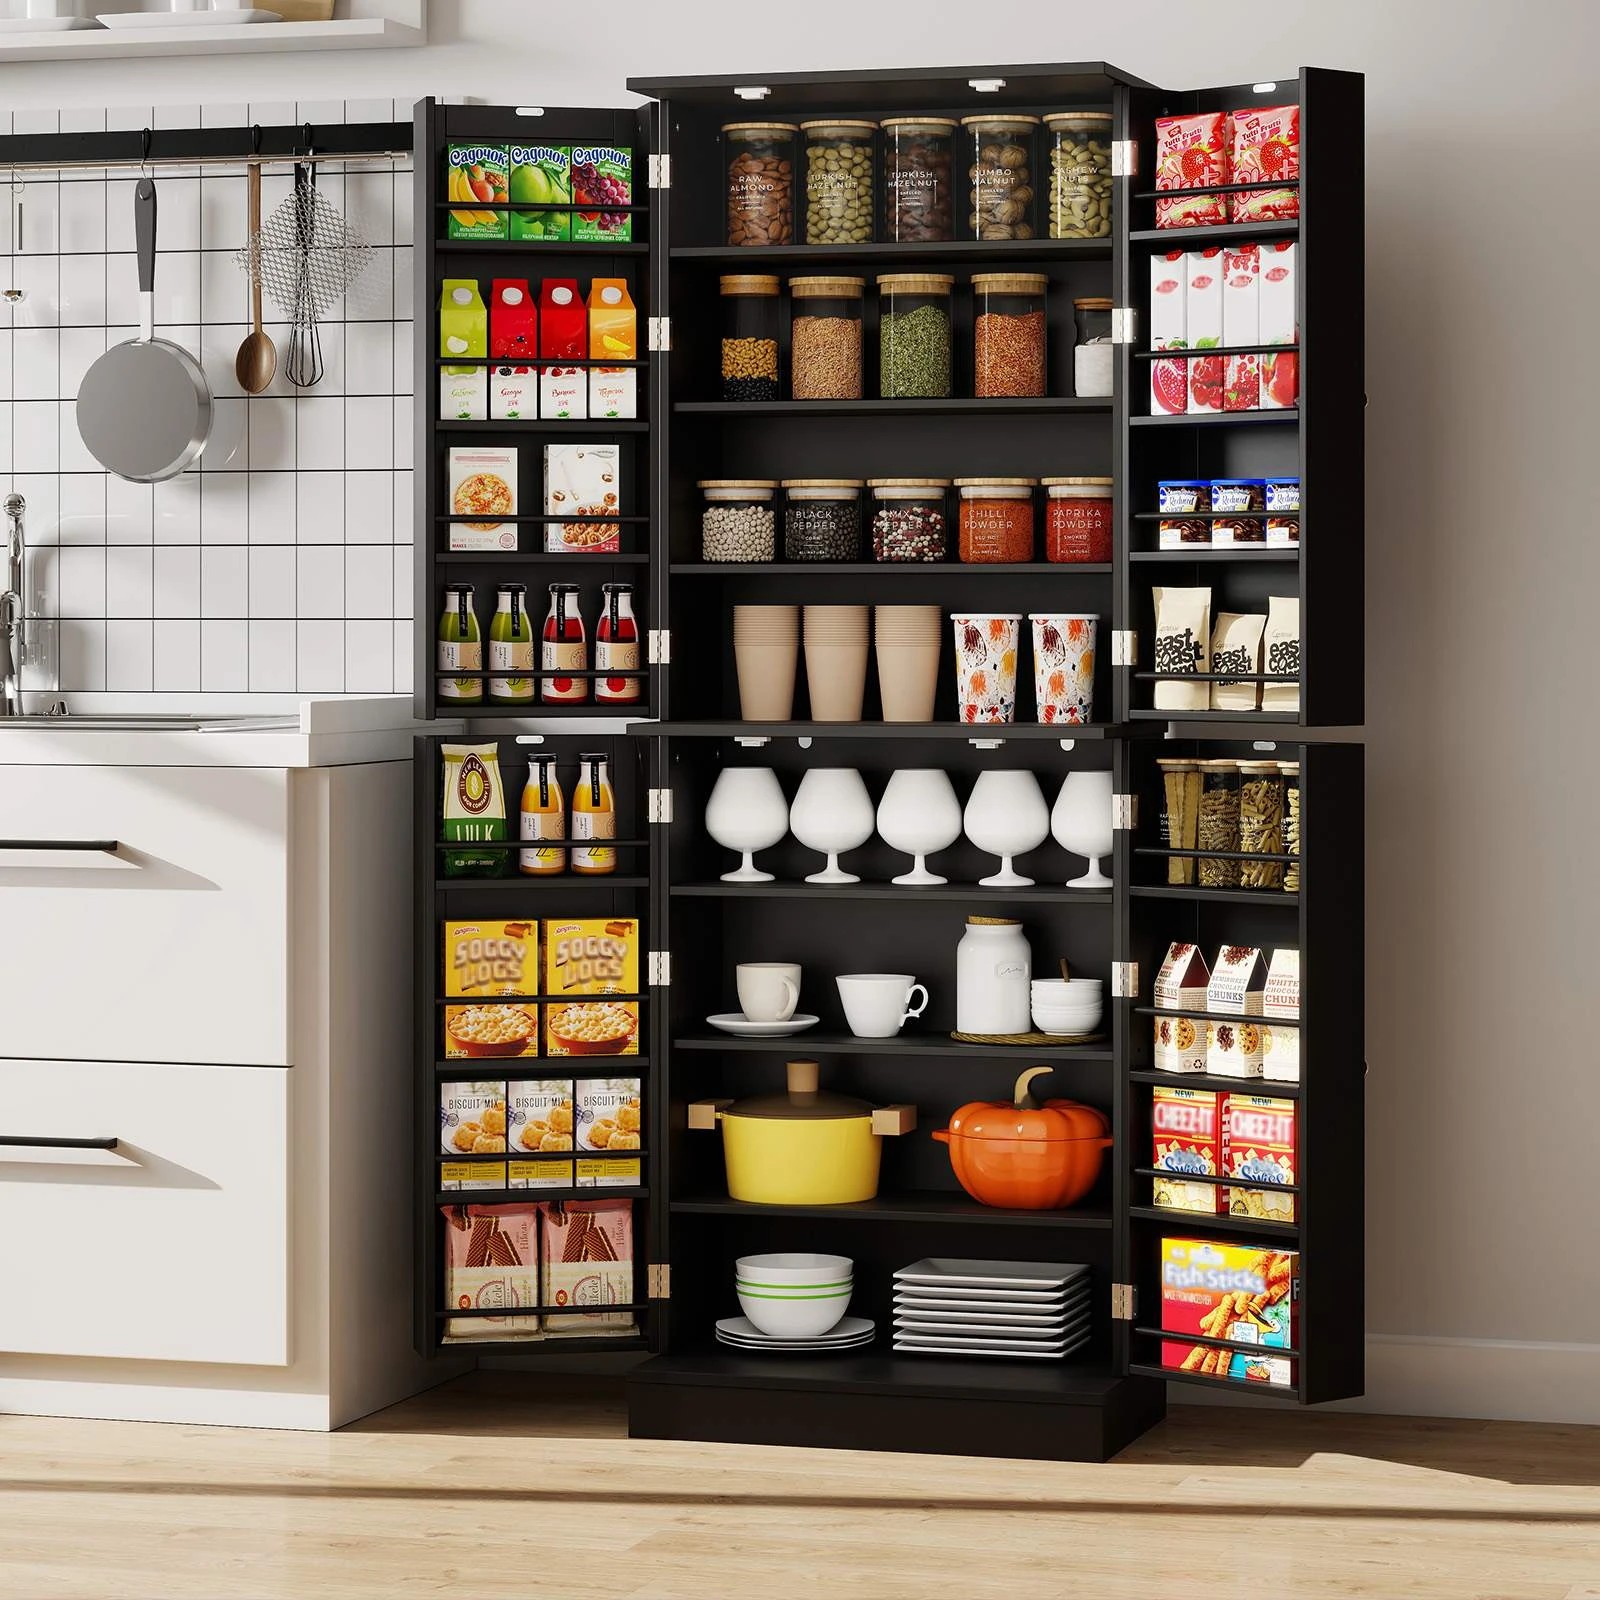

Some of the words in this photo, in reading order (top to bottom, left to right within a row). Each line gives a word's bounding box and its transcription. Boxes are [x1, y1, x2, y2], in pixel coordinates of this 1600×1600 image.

[1242, 128, 1259, 141] Tutti
[1260, 118, 1281, 132] Frutti
[1164, 136, 1181, 148] Tutti
[1182, 127, 1203, 141] Frutti
[449, 148, 508, 167] Садочок
[511, 146, 569, 168] Садочок
[572, 147, 631, 168] Садочок
[891, 171, 932, 179] TURKISH
[974, 168, 1012, 176] JUMBO
[1053, 167, 1098, 175] CASHEW
[738, 175, 762, 183] RAW
[811, 173, 852, 181] TURKISH
[971, 177, 1015, 185] WALNUT
[730, 183, 774, 192] ALMOND
[807, 181, 857, 190] HAZELNUT
[887, 180, 938, 188] HAZELNUT
[795, 510, 832, 519] BLACK
[889, 509, 910, 518] MIX
[969, 509, 1006, 518] CHILLI
[1053, 508, 1102, 518] PAPRIKA
[793, 521, 837, 530] PEPPER
[964, 520, 1013, 529] POWDER
[1053, 520, 1102, 529] POWDER
[1156, 628, 1193, 654] east
[1269, 640, 1299, 658] eas
[1212, 645, 1246, 665] east
[1212, 655, 1253, 675] coast
[1208, 982, 1246, 992] CHOCOLATE
[1268, 978, 1299, 987] WHITE
[1265, 986, 1299, 995] CHOCOL
[1208, 989, 1244, 1002] CHUNKS
[1174, 1089, 1194, 1099] NEW!
[449, 1097, 481, 1110] BISCUIT
[484, 1097, 499, 1108] MIX
[515, 1096, 548, 1108] BISCUIT
[551, 1096, 566, 1107] MIX
[583, 1095, 615, 1107] BISCUIT
[618, 1094, 634, 1106] MIX
[1251, 1096, 1271, 1106] NEW!
